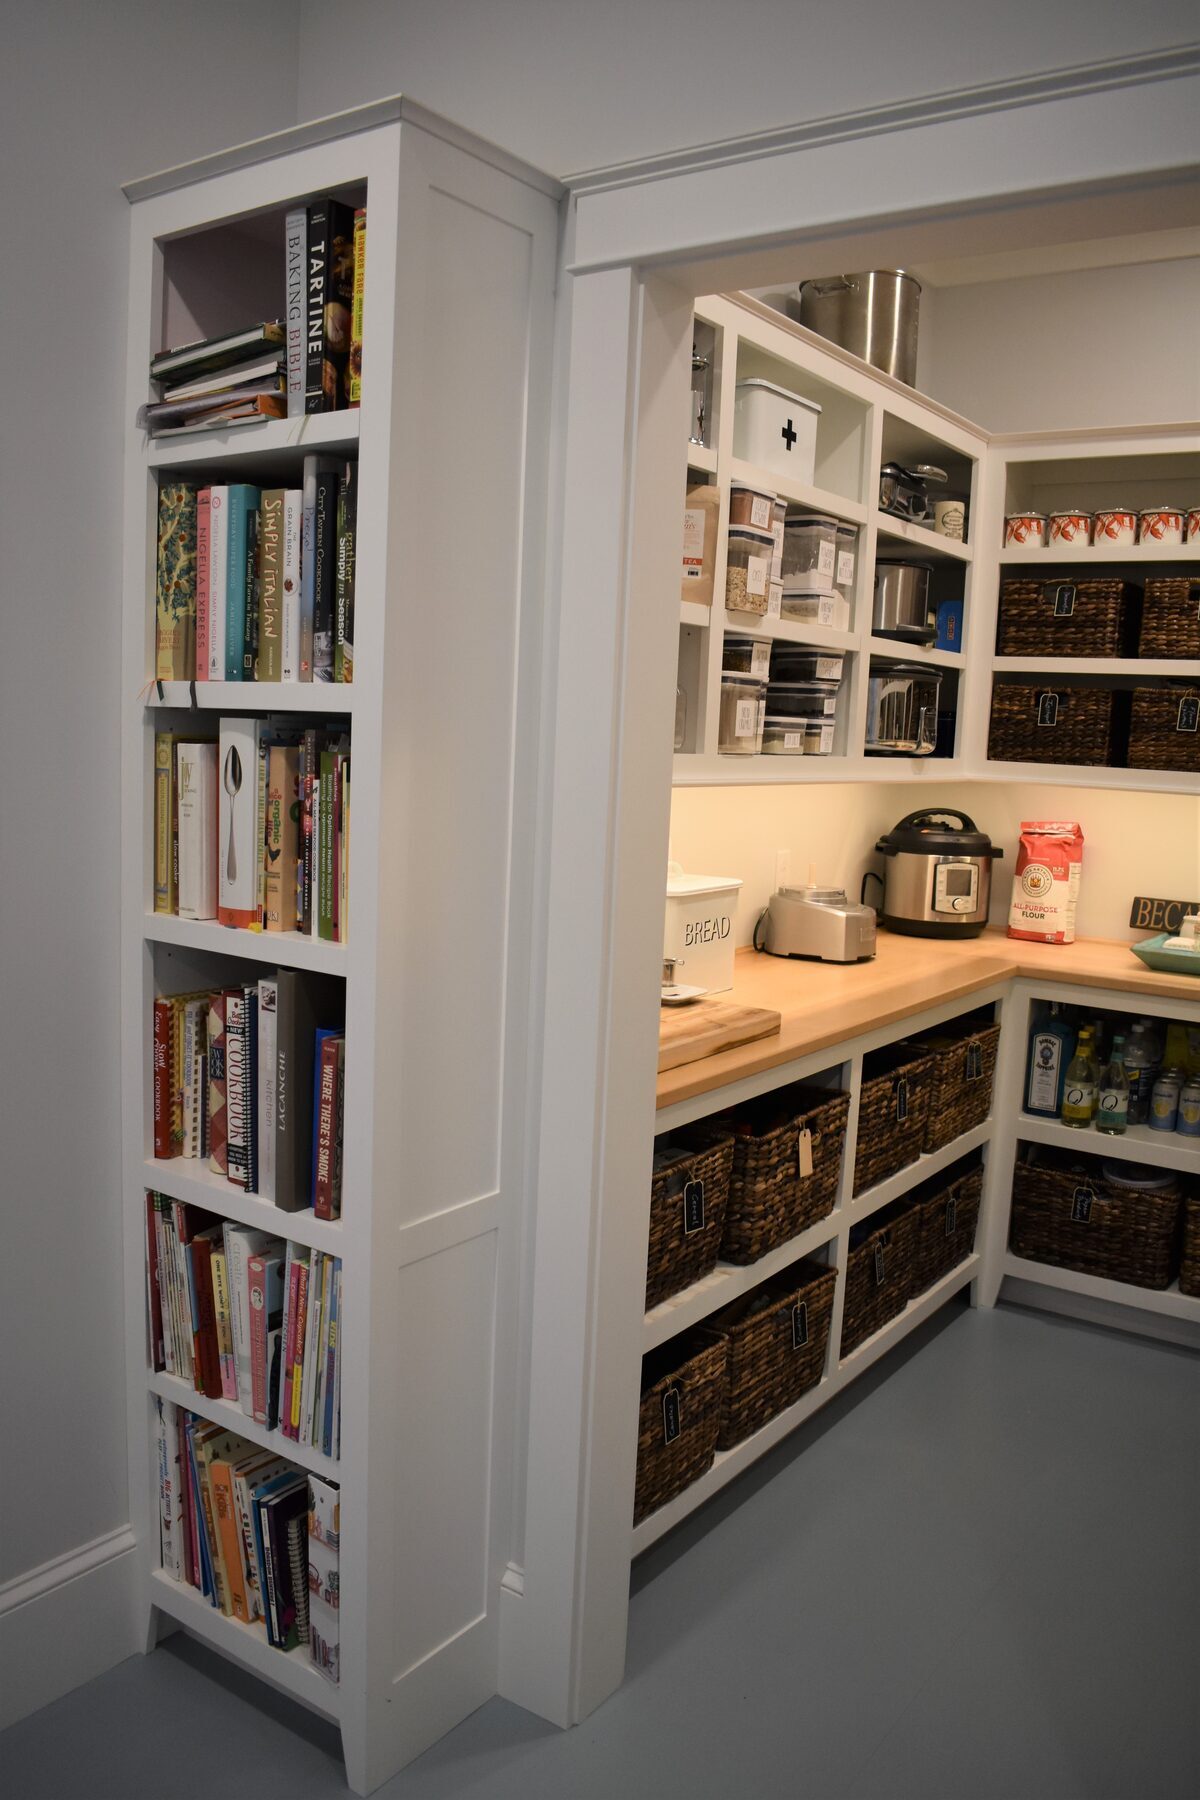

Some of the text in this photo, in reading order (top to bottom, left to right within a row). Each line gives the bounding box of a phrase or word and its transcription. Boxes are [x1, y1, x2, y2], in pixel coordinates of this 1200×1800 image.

[288, 235, 301, 321] BAKING
[308, 241, 326, 354] TARTINE
[288, 328, 302, 395] BIBLE
[317, 511, 326, 547] TAVERN
[245, 559, 254, 582] Family
[247, 550, 254, 558] A
[337, 538, 347, 581] Simply
[344, 532, 356, 583] gather
[197, 527, 208, 649] NIGELLA EXPRESS
[316, 549, 325, 603] COOKBOOK
[244, 613, 252, 641] Tuscany
[337, 597, 345, 646] Season
[272, 799, 281, 845] organic
[685, 917, 731, 946] BREAD
[1021, 911, 1046, 920] FLOUR
[158, 1043, 167, 1068] SLOW
[228, 1038, 244, 1145] COOKBOOK
[265, 1079, 275, 1127] kitchen
[278, 1051, 286, 1132] LACANCHE
[1067, 1088, 1084, 1106] Q
[1101, 1094, 1118, 1112] Q
[317, 1065, 333, 1183] WHERE THERE'S SMOKE
[691, 1194, 700, 1226] Cereal
[299, 1268, 307, 1295] What's
[296, 1317, 304, 1355] Cupcake?
[329, 1320, 337, 1348] KIDS
[164, 1479, 172, 1492] BIG
[250, 1565, 260, 1593] PLAY
